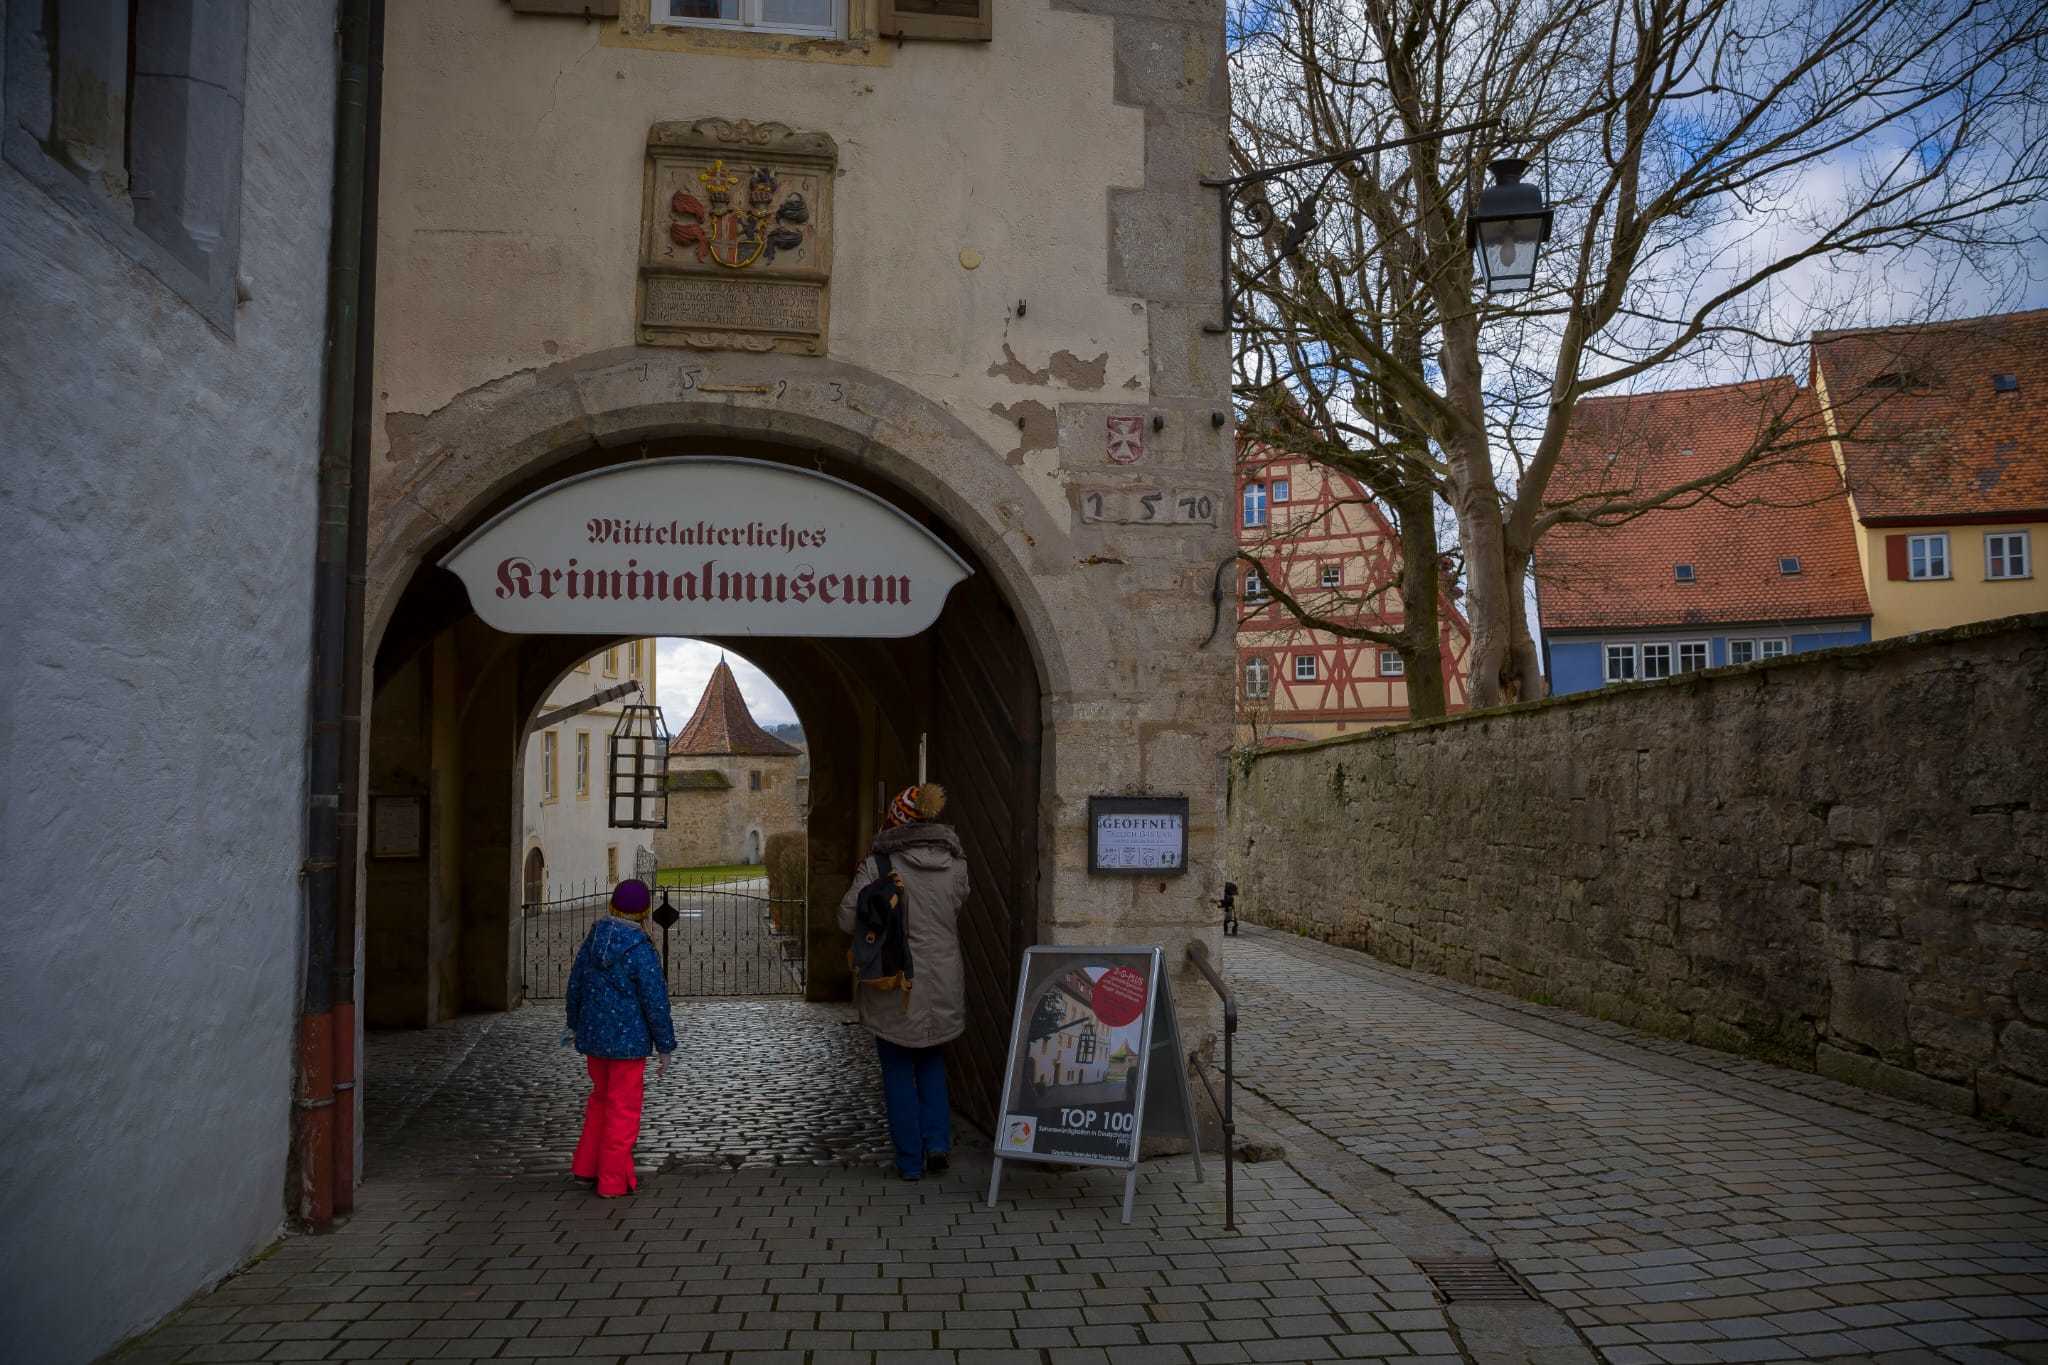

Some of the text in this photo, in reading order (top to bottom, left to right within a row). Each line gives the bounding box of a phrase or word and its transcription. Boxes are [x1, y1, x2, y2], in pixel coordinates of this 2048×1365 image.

[586, 518, 827, 553] Mittelalterliches
[495, 556, 912, 606] Kriminalmuseum
[1061, 1107, 1133, 1132] TOP 100
